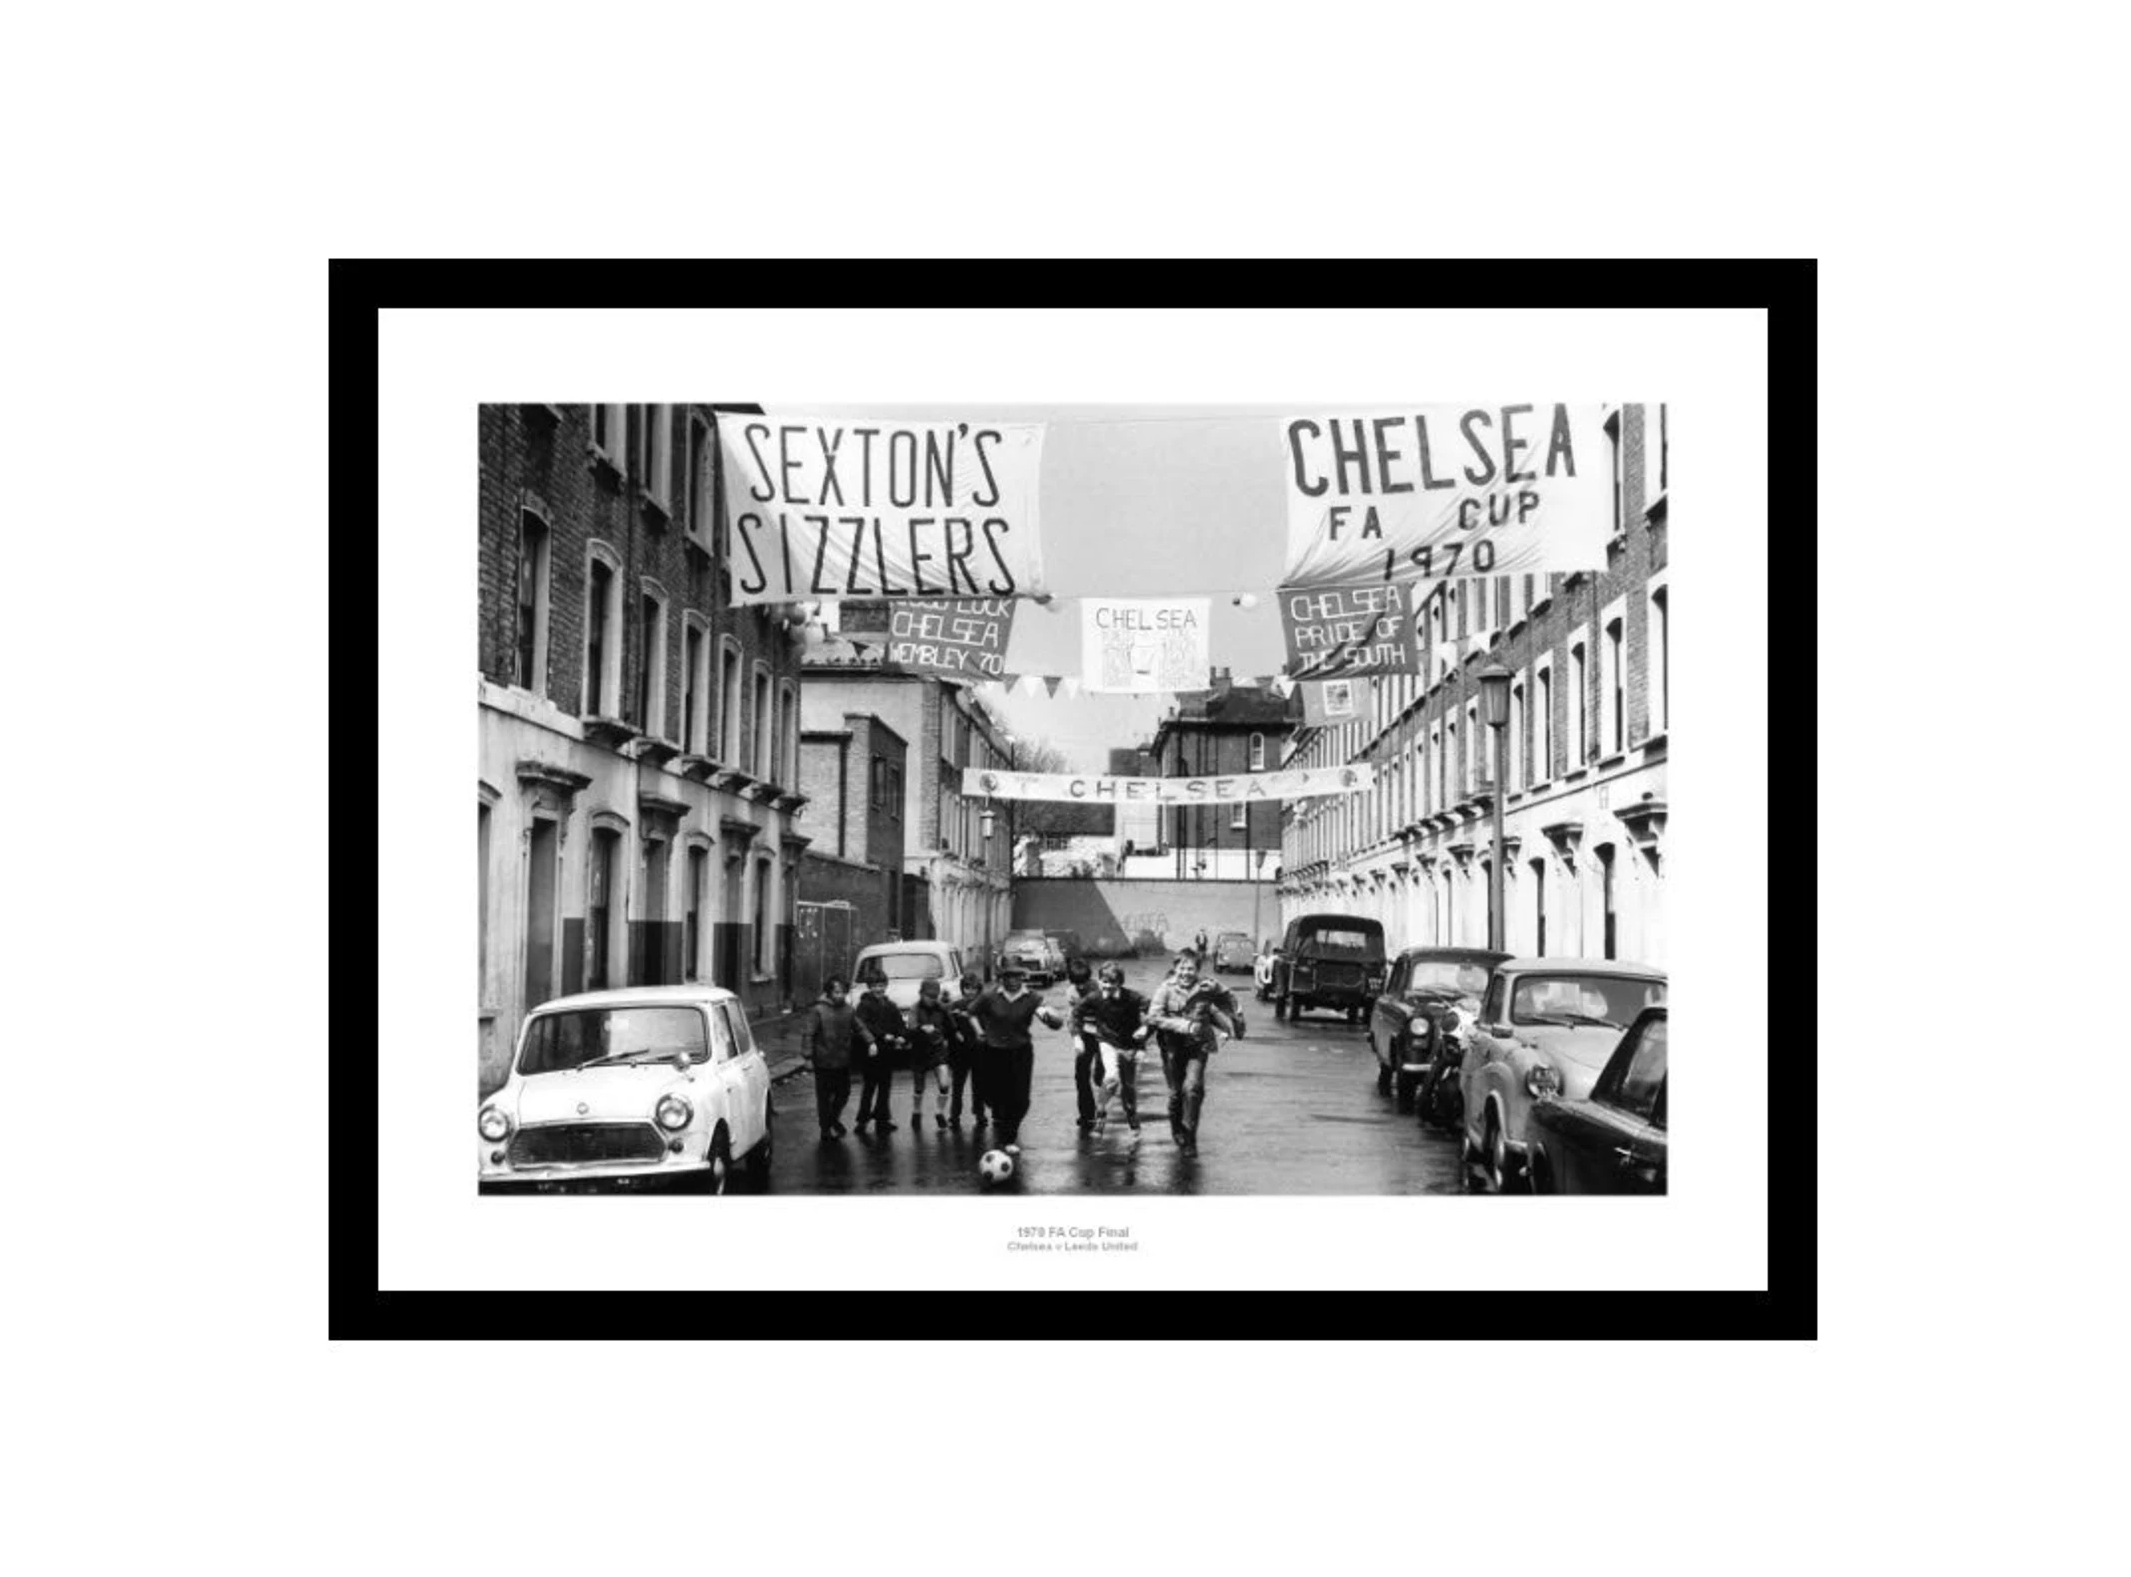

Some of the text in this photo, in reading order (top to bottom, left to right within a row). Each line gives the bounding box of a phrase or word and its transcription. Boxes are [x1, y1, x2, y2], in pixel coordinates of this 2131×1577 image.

[745, 422, 1002, 508] SEXTON'S
[1288, 402, 1577, 498] CHELSEA
[1329, 490, 1541, 541] FA CUP
[737, 512, 1016, 596] SIZZLERS
[1383, 539, 1496, 581] 1970
[1096, 606, 1198, 631] CHELSEA
[1290, 585, 1403, 621] CHELSEA
[892, 610, 999, 649] CHELSEA
[1295, 615, 1404, 649] PRIDE OF
[889, 641, 1004, 676] WEMBLEY 70
[1343, 642, 1407, 669] SOUTH
[1069, 778, 1267, 801] CHELSEA
